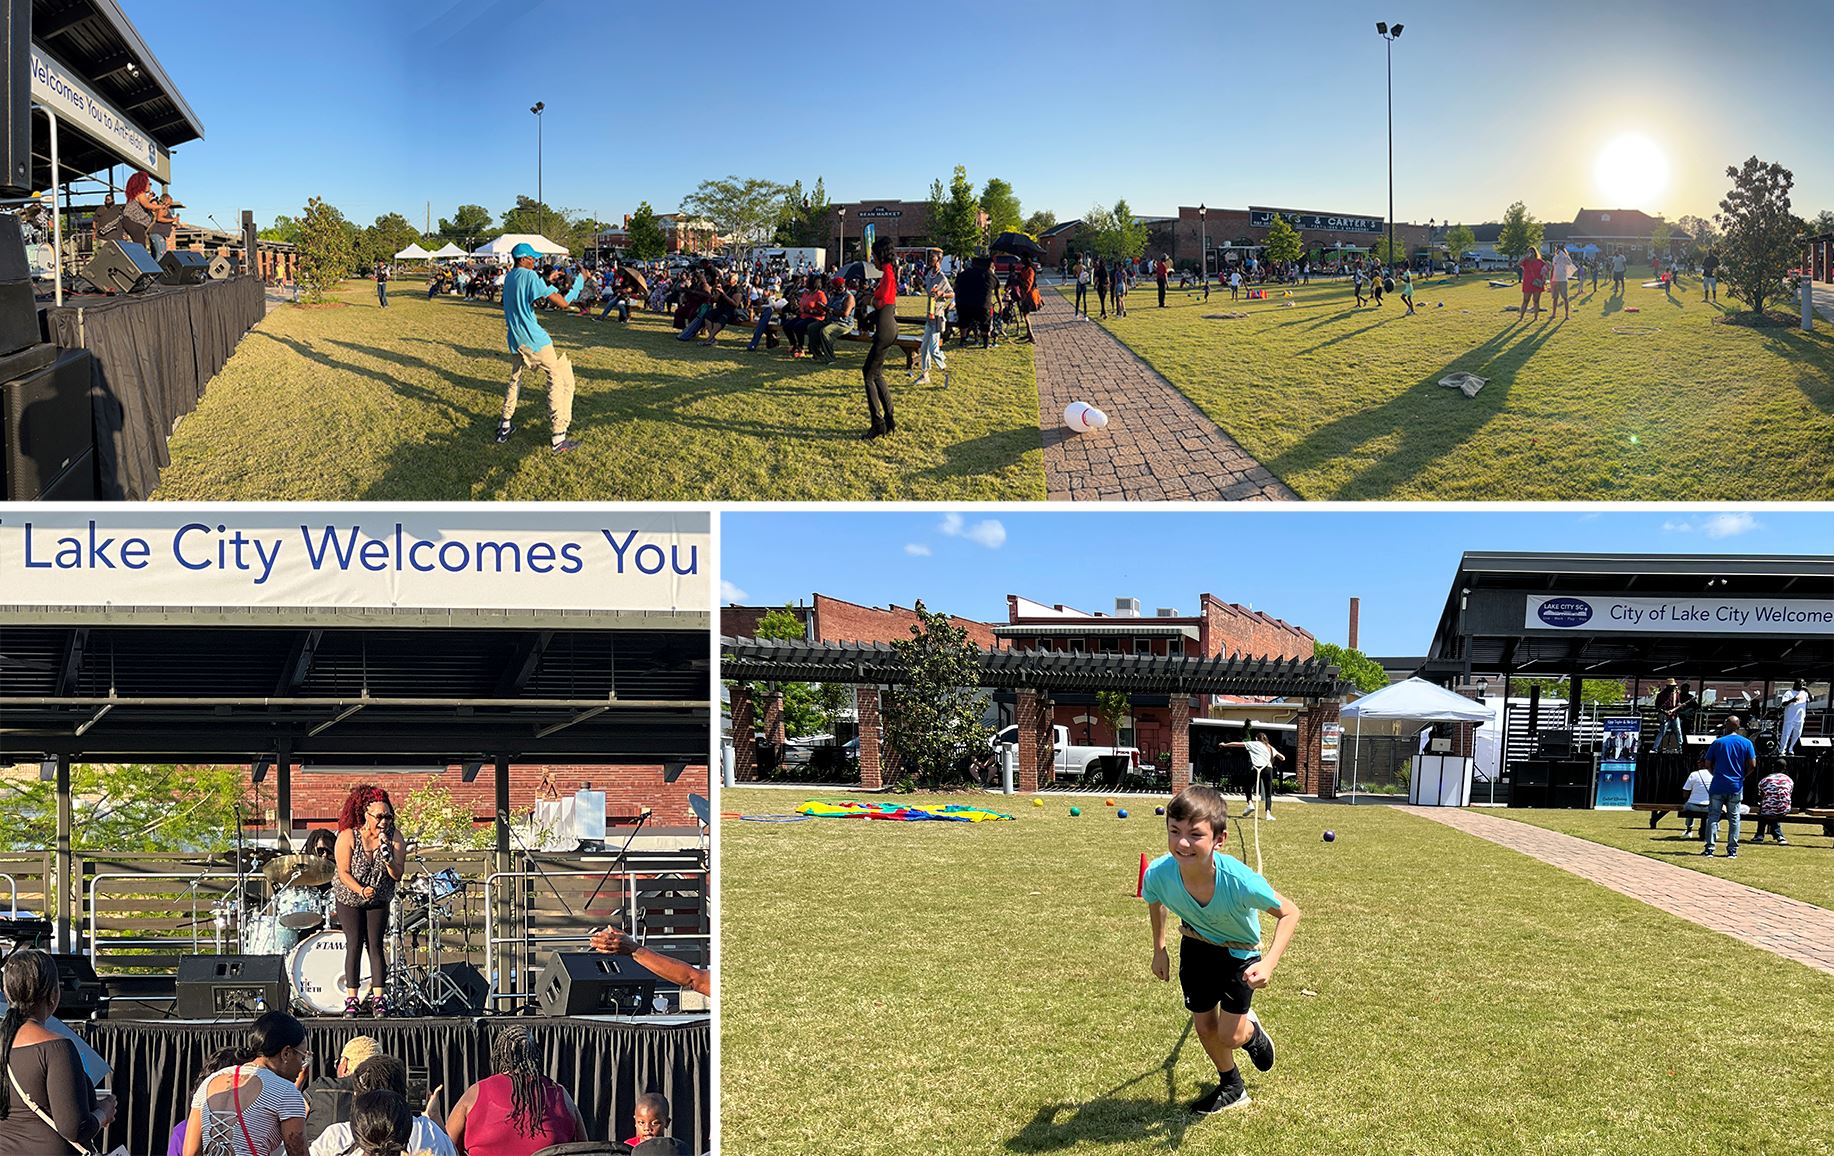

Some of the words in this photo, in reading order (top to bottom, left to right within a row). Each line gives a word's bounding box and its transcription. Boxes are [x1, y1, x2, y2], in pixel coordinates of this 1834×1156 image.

[86, 95, 103, 123] You
[104, 114, 113, 129] to
[1314, 216, 1321, 225] &
[1327, 217, 1376, 228] CARTER'S
[24, 520, 150, 569] Lake
[173, 524, 282, 584] City
[301, 524, 583, 574] Welcomes
[602, 529, 697, 575] You
[1610, 604, 1643, 625] City
[1649, 604, 1668, 620] of
[1671, 602, 1710, 621] Lake
[1715, 605, 1750, 626] City
